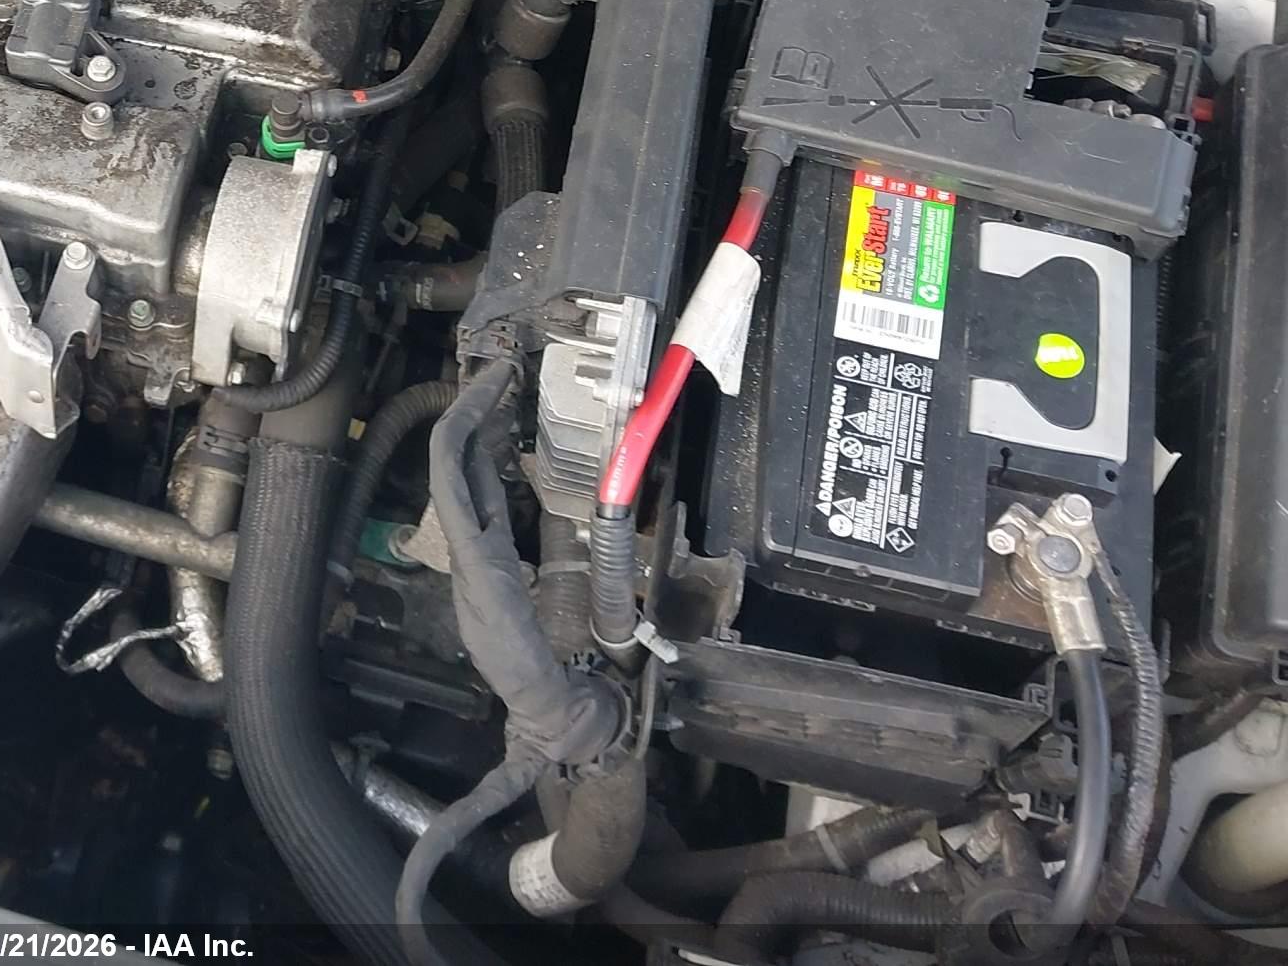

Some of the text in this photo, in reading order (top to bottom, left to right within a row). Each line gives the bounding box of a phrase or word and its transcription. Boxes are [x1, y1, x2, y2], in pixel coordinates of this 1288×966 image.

[856, 206, 891, 293] EverStart
[915, 423, 924, 431] DO
[819, 384, 848, 501] DANGER/POISON
[896, 438, 905, 455] READ
[913, 440, 922, 451] NOT
